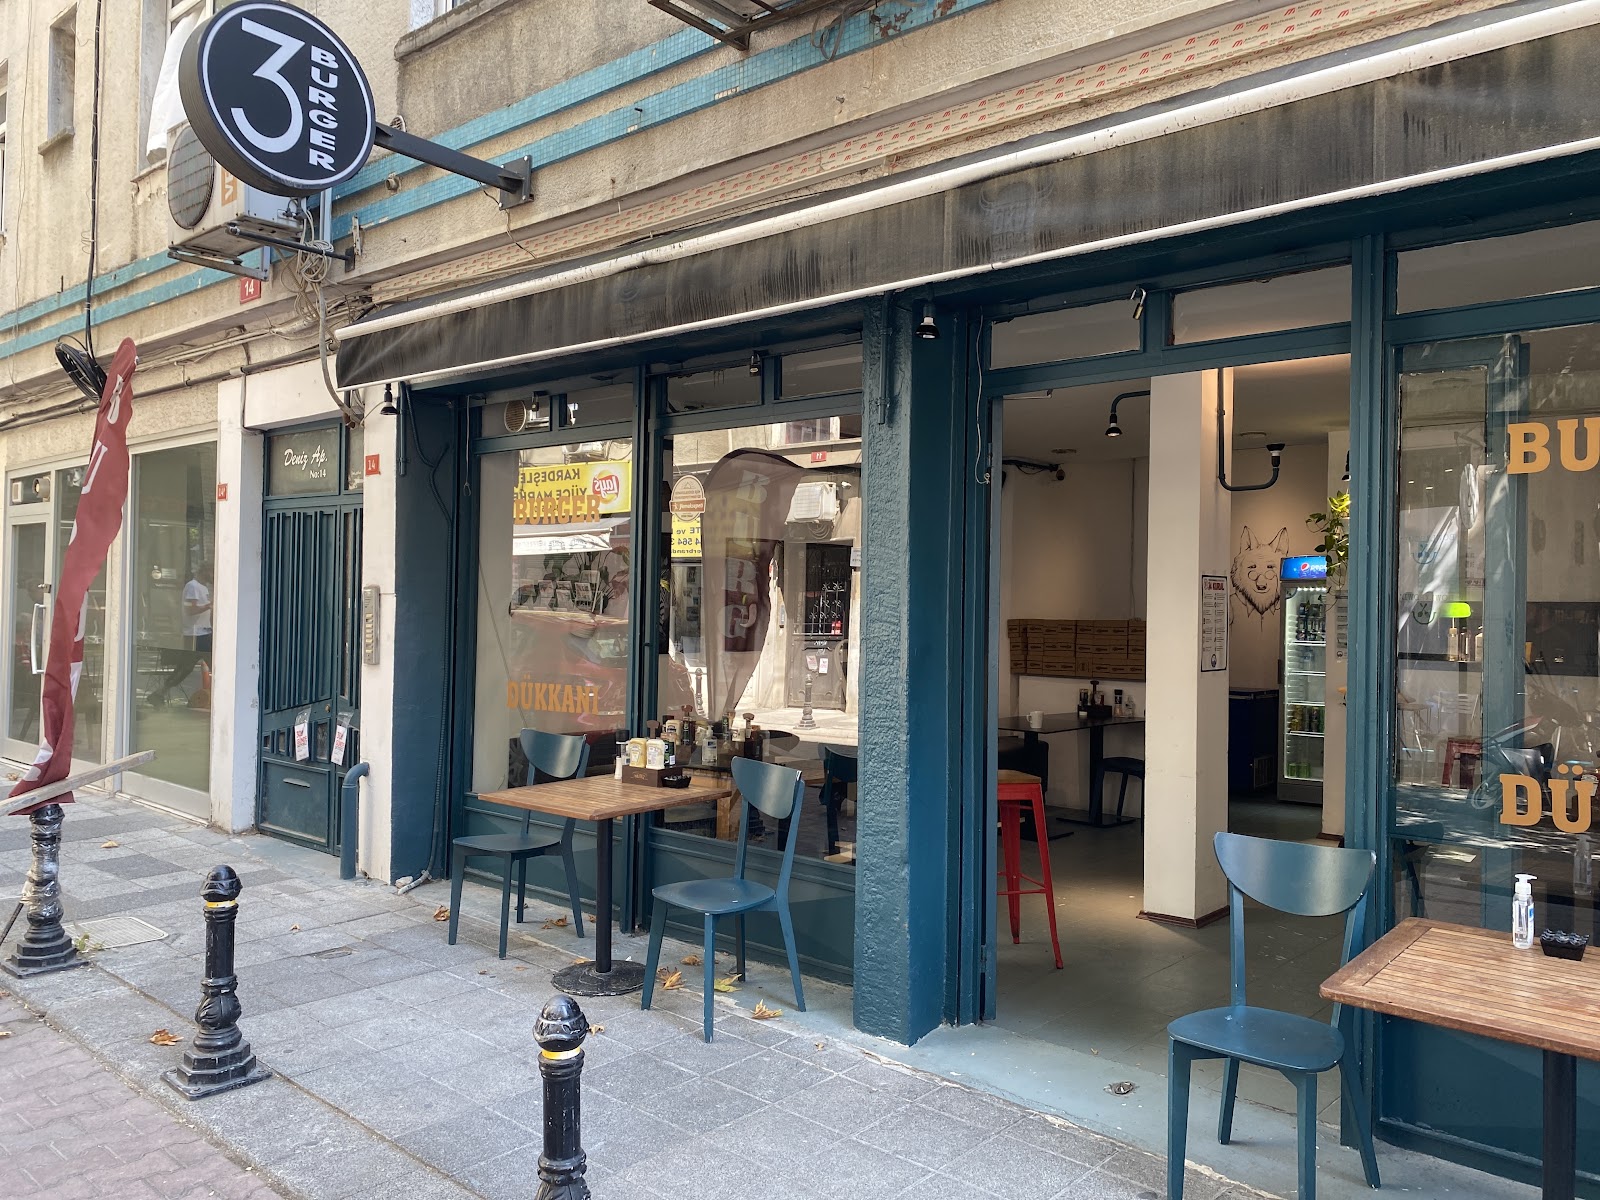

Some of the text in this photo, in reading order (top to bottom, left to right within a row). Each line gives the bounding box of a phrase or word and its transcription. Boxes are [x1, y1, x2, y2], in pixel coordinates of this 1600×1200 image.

[231, 17, 305, 153] 3
[308, 45, 339, 172] BURGER
[244, 279, 255, 297] 14
[284, 448, 309, 471] Deniz
[1507, 416, 1600, 475] BU
[310, 468, 327, 479] No:14
[367, 459, 376, 471] 14
[514, 494, 600, 526] BURGER
[506, 673, 599, 715] DÜKKANI
[1499, 763, 1593, 834] DÜ
